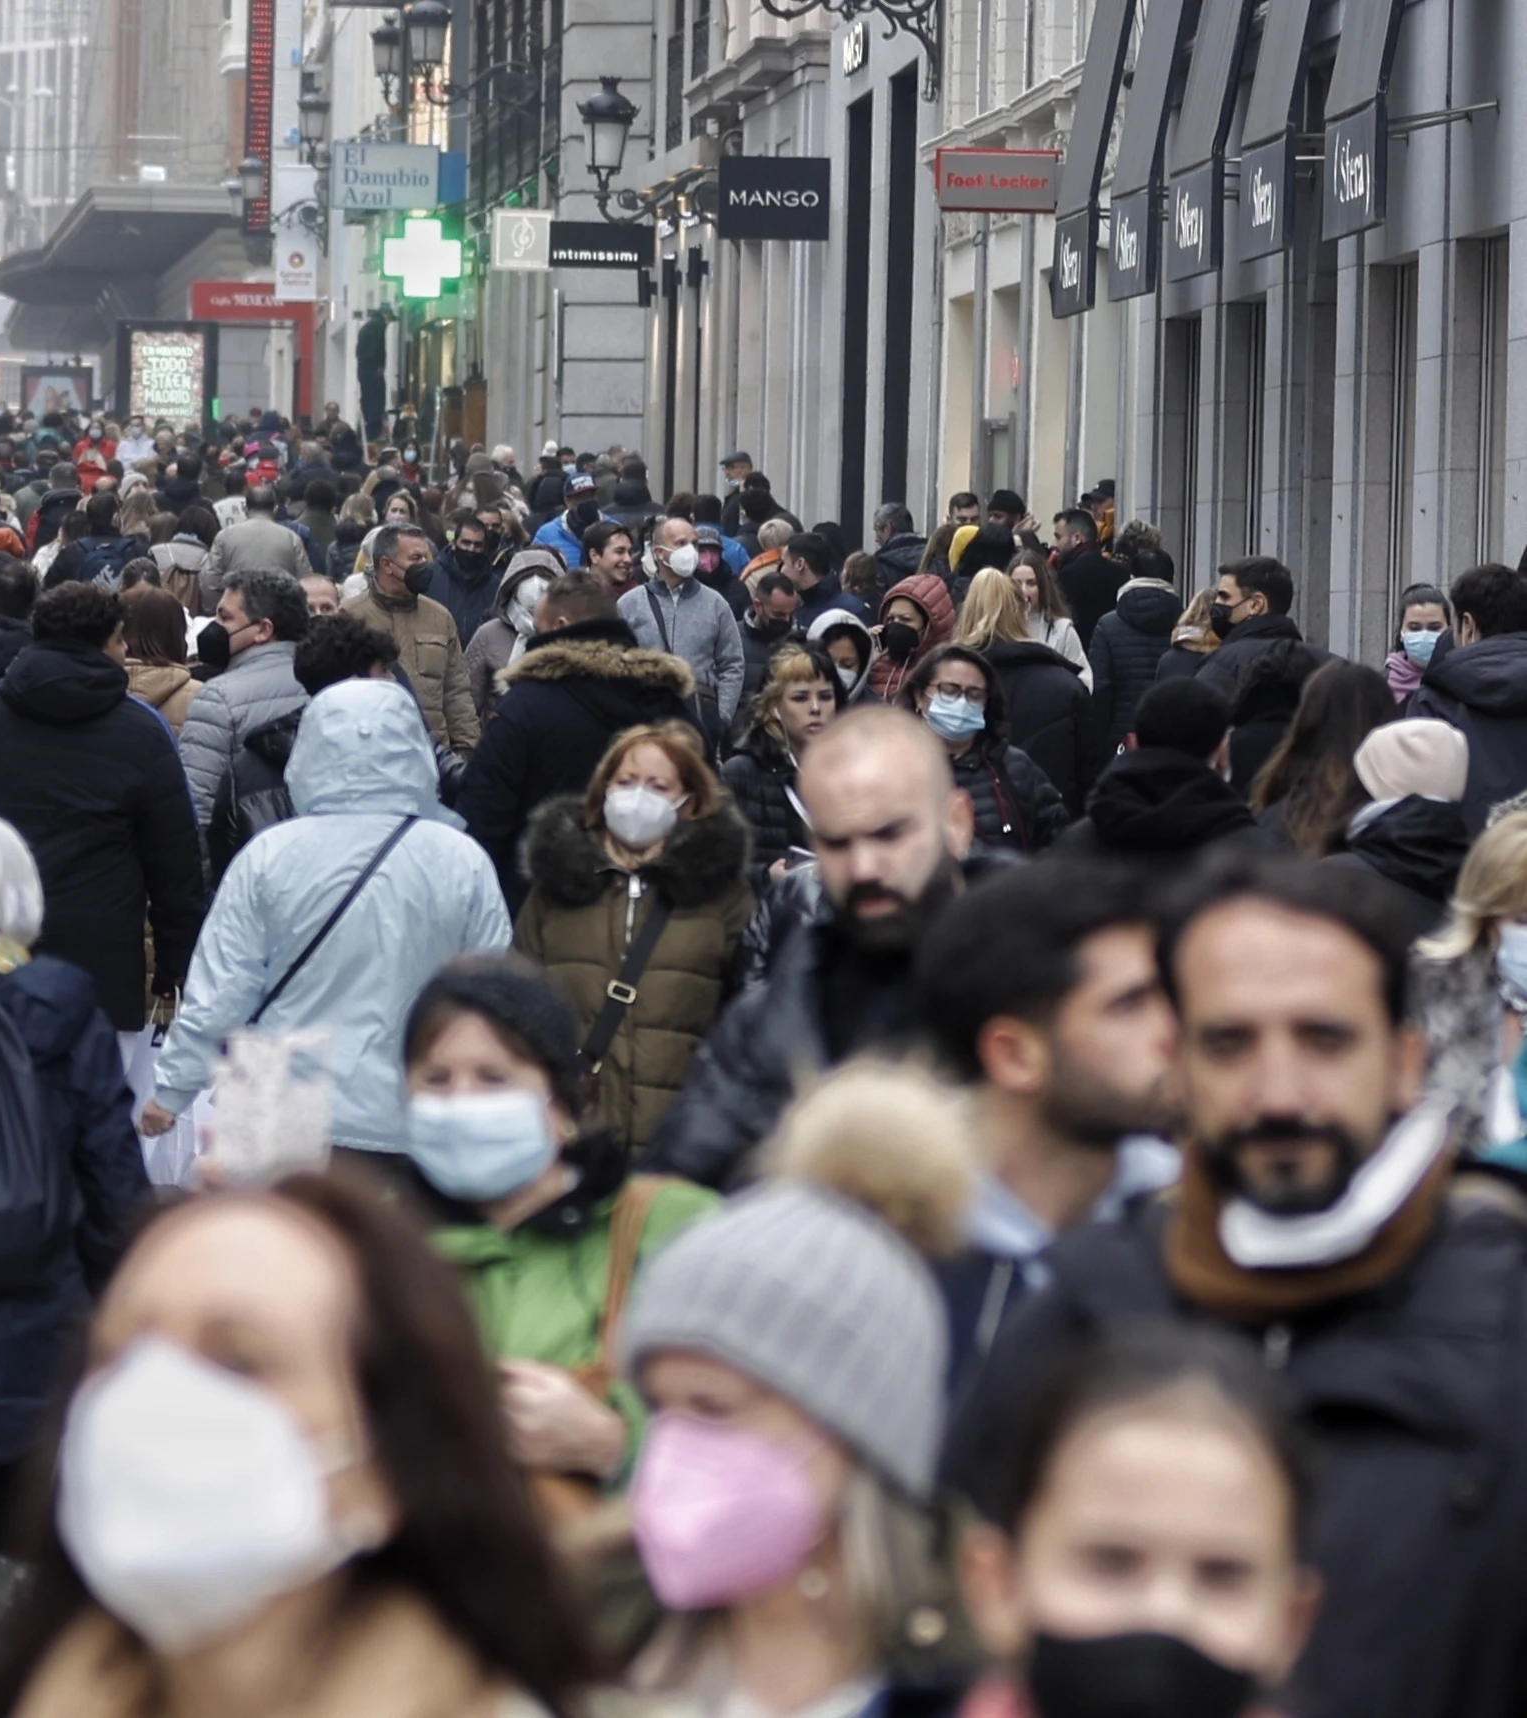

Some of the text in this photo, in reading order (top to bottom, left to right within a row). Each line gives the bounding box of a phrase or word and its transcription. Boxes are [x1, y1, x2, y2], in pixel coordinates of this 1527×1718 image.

[344, 147, 366, 166] El
[343, 167, 430, 187] Danubio
[947, 172, 1049, 190] Foot Locker
[344, 188, 393, 207] Azul
[729, 190, 820, 208] MANGO
[552, 249, 639, 262] intimissimi
[147, 356, 188, 373] TODO
